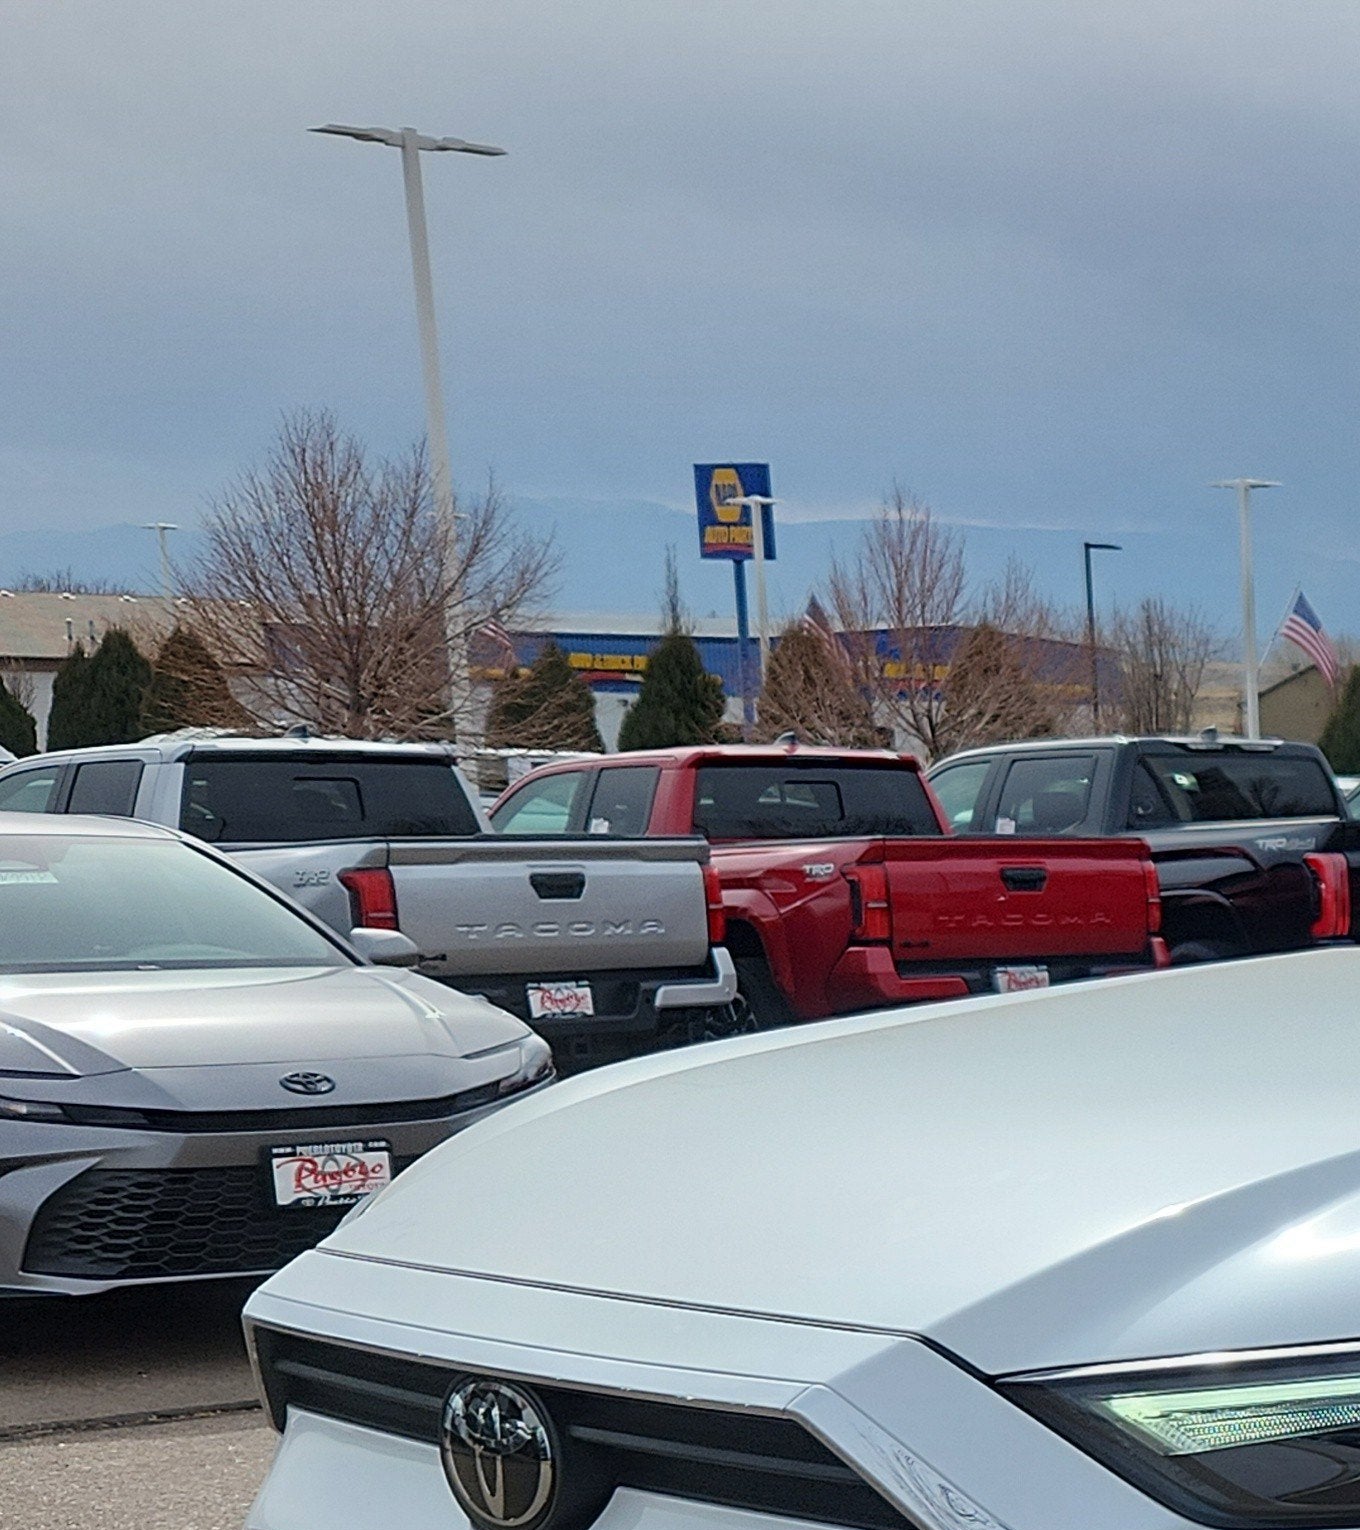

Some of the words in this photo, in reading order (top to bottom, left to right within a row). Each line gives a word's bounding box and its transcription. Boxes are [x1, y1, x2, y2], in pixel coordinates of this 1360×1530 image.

[802, 863, 834, 875] TRD
[455, 919, 666, 940] TACOMA
[938, 913, 1112, 928] TACOMA
[276, 1157, 384, 1191] Pueblo
